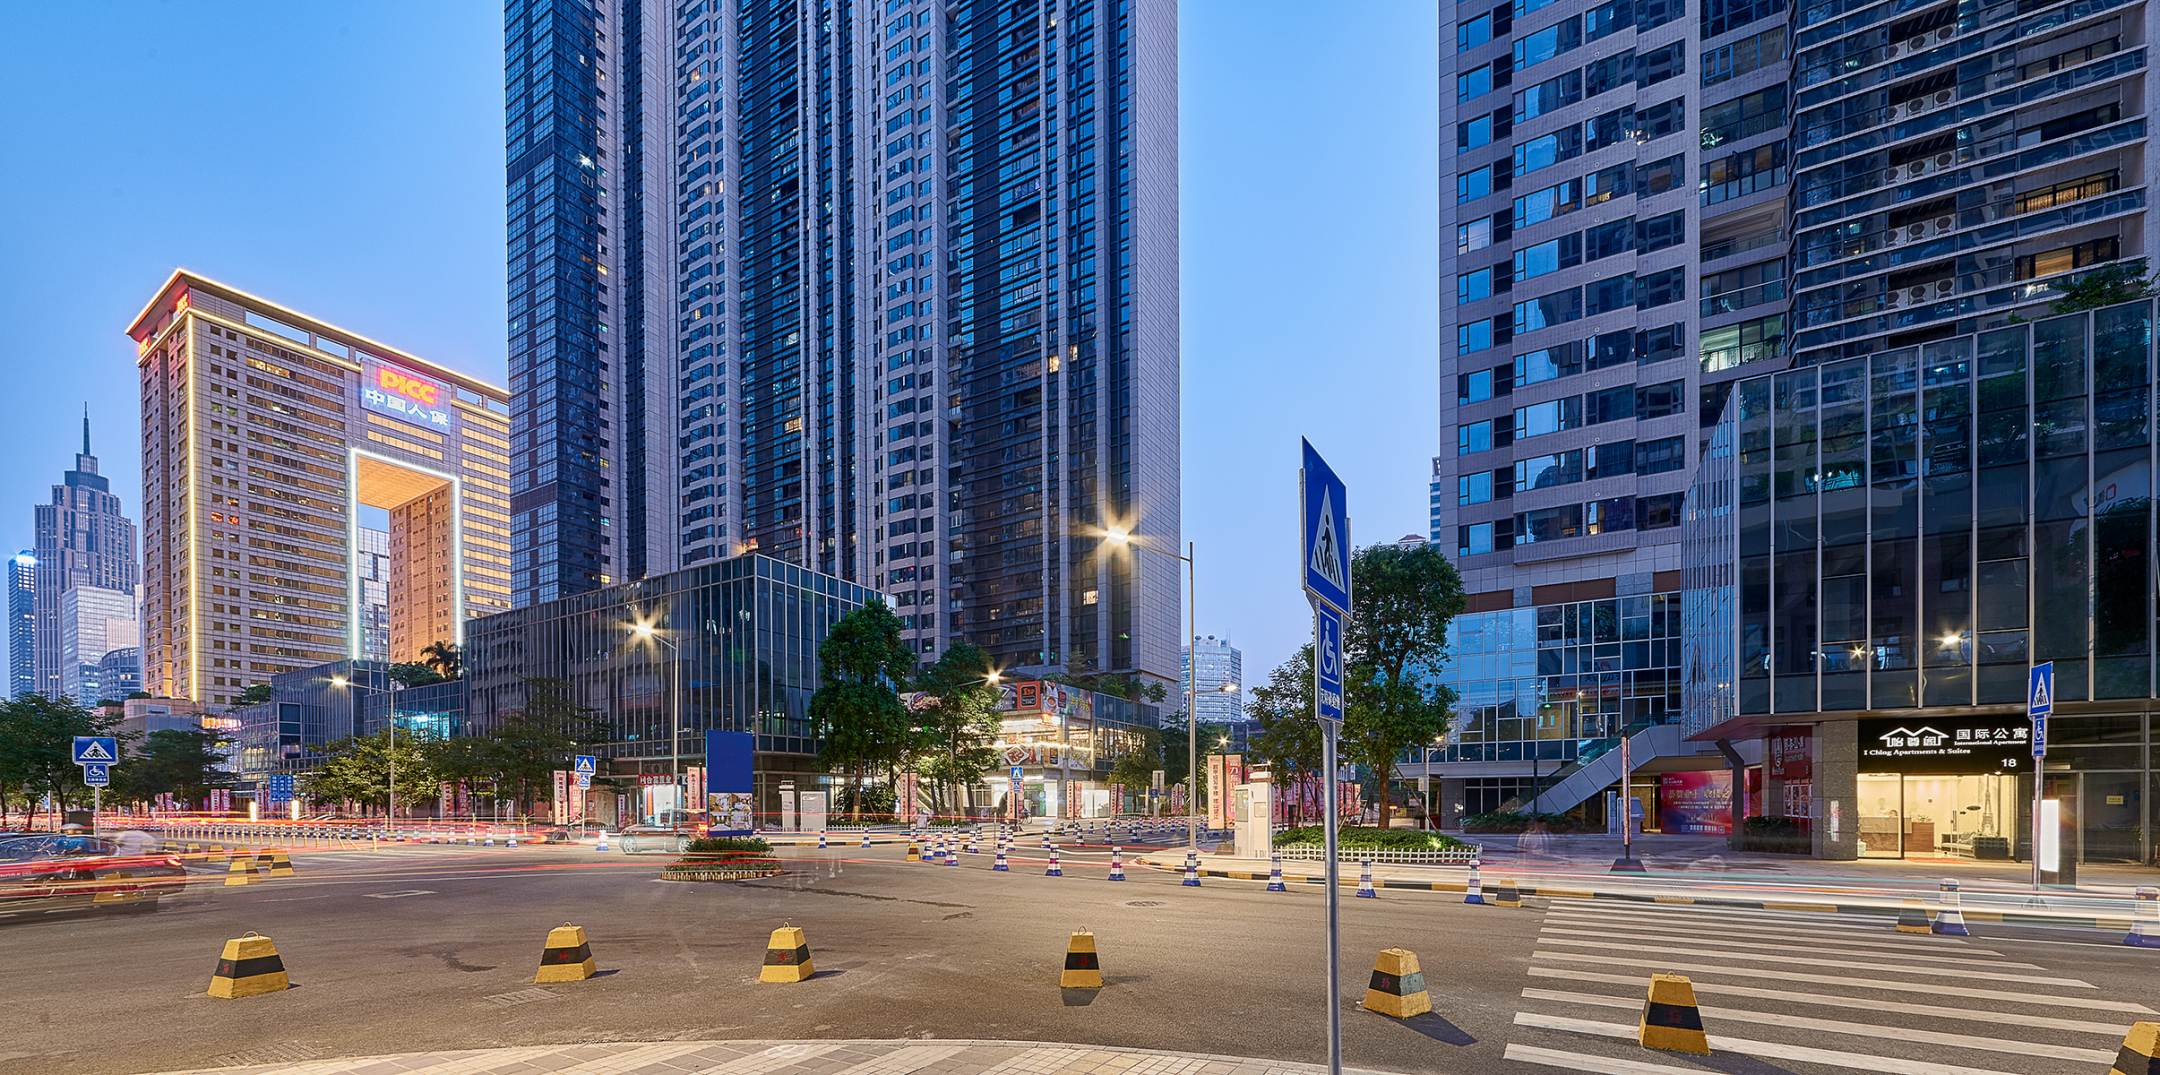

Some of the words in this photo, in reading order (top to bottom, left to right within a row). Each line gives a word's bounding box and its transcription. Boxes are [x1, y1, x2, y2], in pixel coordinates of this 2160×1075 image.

[379, 368, 436, 405] PICC
[1956, 727, 2029, 741] 国际公寓
[1993, 739, 2027, 747] Apartment
[1893, 749, 1937, 757] Apartments
[2000, 758, 2017, 768] 18
